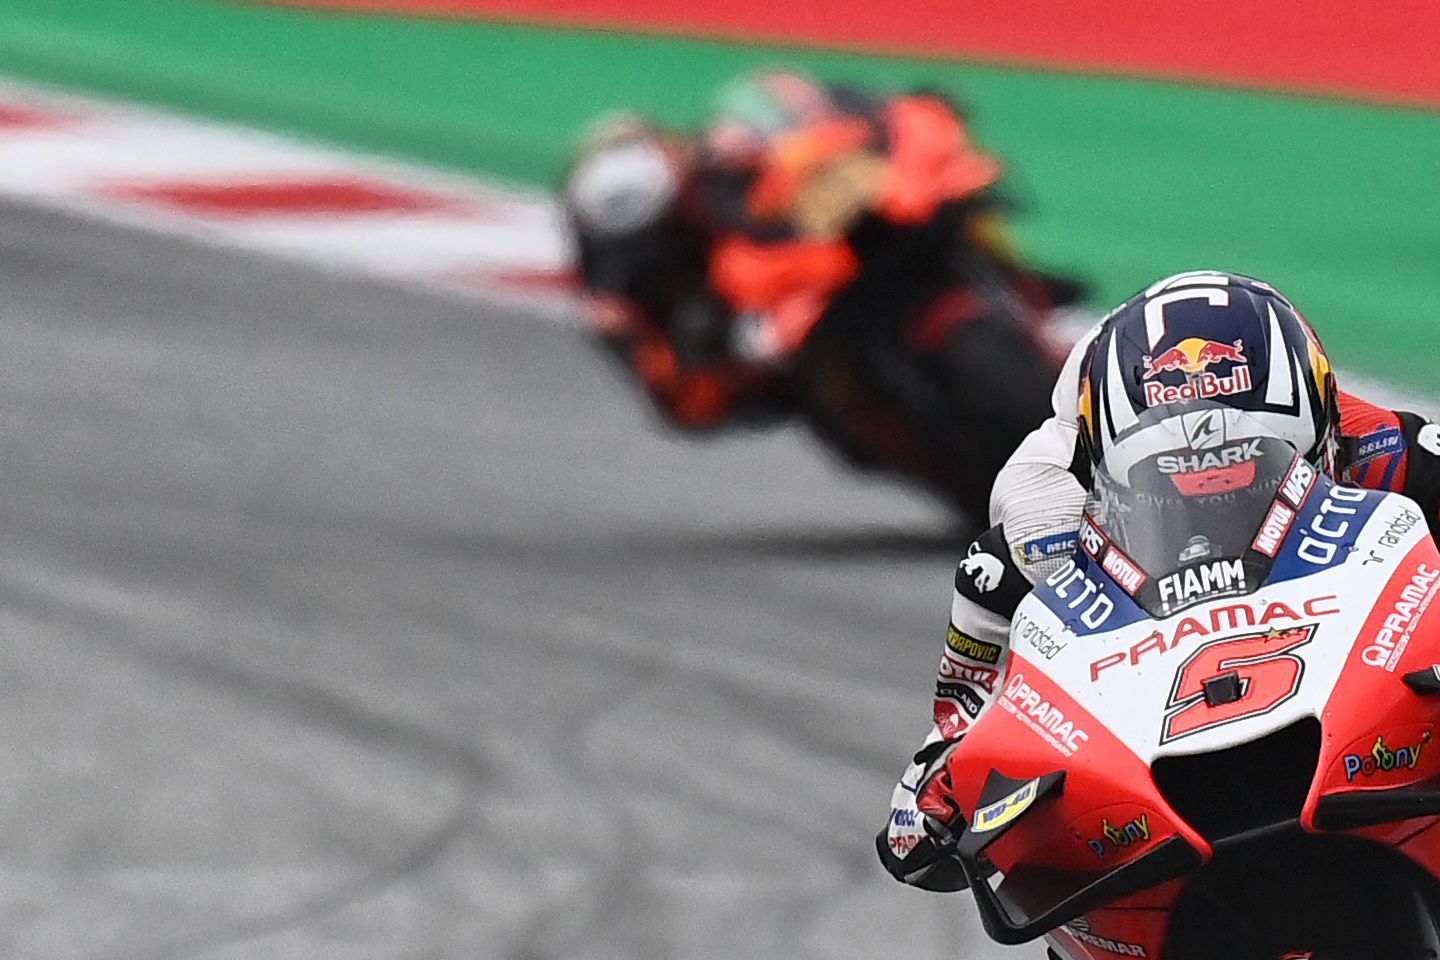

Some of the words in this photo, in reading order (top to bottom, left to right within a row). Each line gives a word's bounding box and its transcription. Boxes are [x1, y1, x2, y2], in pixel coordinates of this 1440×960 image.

[1144, 380, 1198, 407] Red
[1200, 365, 1252, 398] Bull
[1157, 438, 1264, 474] SHARK
[1256, 501, 1294, 554] MOTUL
[1297, 482, 1368, 565] OCTO
[1377, 504, 1422, 548] randstad
[1045, 558, 1114, 630] OCTO
[1102, 549, 1142, 592] MOTUL
[1158, 558, 1246, 606] FIAMM
[1374, 563, 1440, 649] PRAMAC
[1089, 595, 1340, 683] PRAMAC
[1010, 681, 1089, 752] PRAMAC
